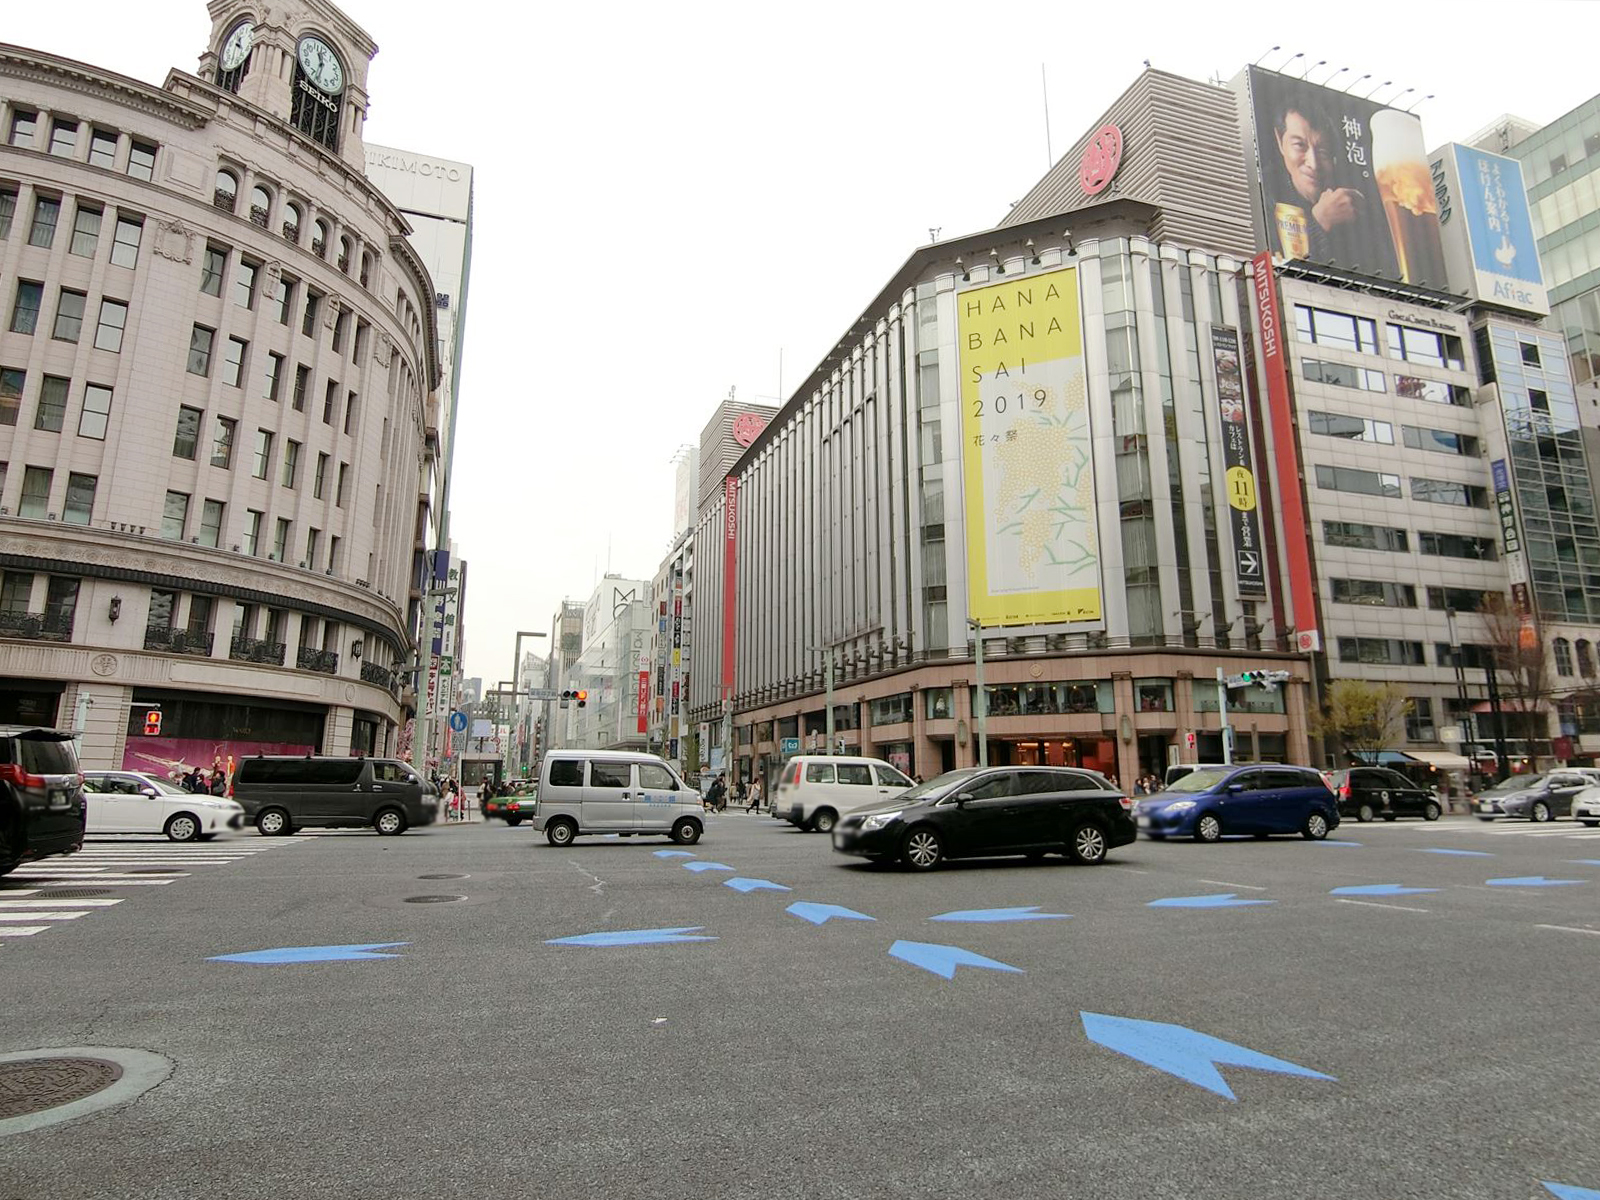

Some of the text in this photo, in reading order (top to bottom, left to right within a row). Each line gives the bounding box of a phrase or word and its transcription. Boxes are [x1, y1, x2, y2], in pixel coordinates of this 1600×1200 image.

[299, 80, 338, 113] SEIKO
[1341, 115, 1370, 179] 神泡。
[365, 151, 461, 182] IKIMOTO
[967, 283, 1060, 318] HANA
[1255, 259, 1276, 357] MITSUKOSHI
[1493, 281, 1533, 305] Aflac
[968, 317, 1062, 351] BANA
[972, 357, 1026, 384] SAI
[972, 389, 1047, 418] 2019
[973, 429, 1018, 447] 花々祭
[727, 481, 736, 539] MITSUKOSHI
[441, 659, 451, 673] 本
